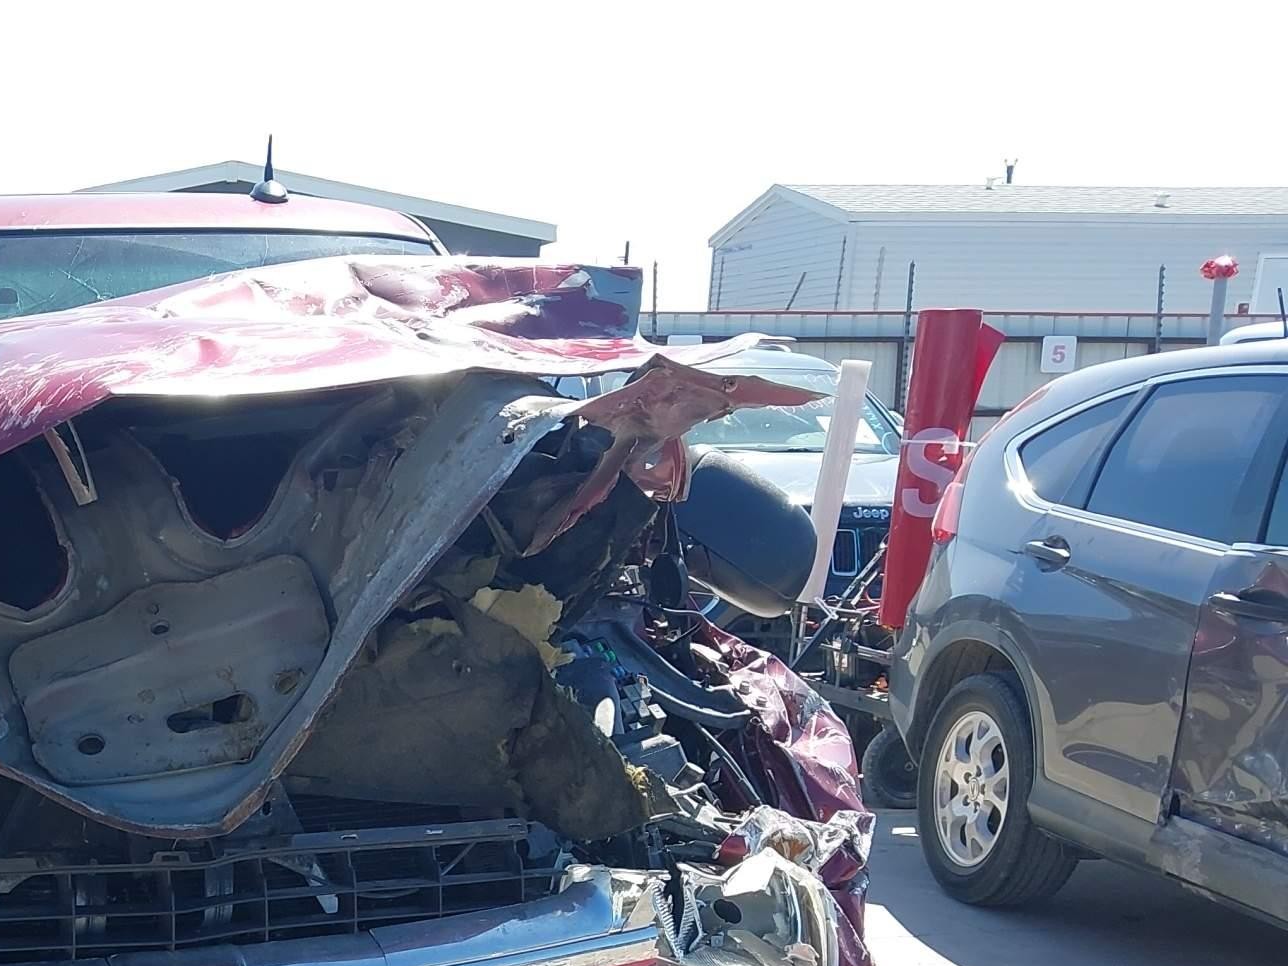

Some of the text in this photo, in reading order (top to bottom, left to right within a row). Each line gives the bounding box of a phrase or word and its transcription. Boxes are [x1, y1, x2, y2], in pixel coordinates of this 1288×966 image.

[1052, 345, 1066, 364] 5
[902, 427, 958, 518] S
[853, 506, 890, 520] Jeep
